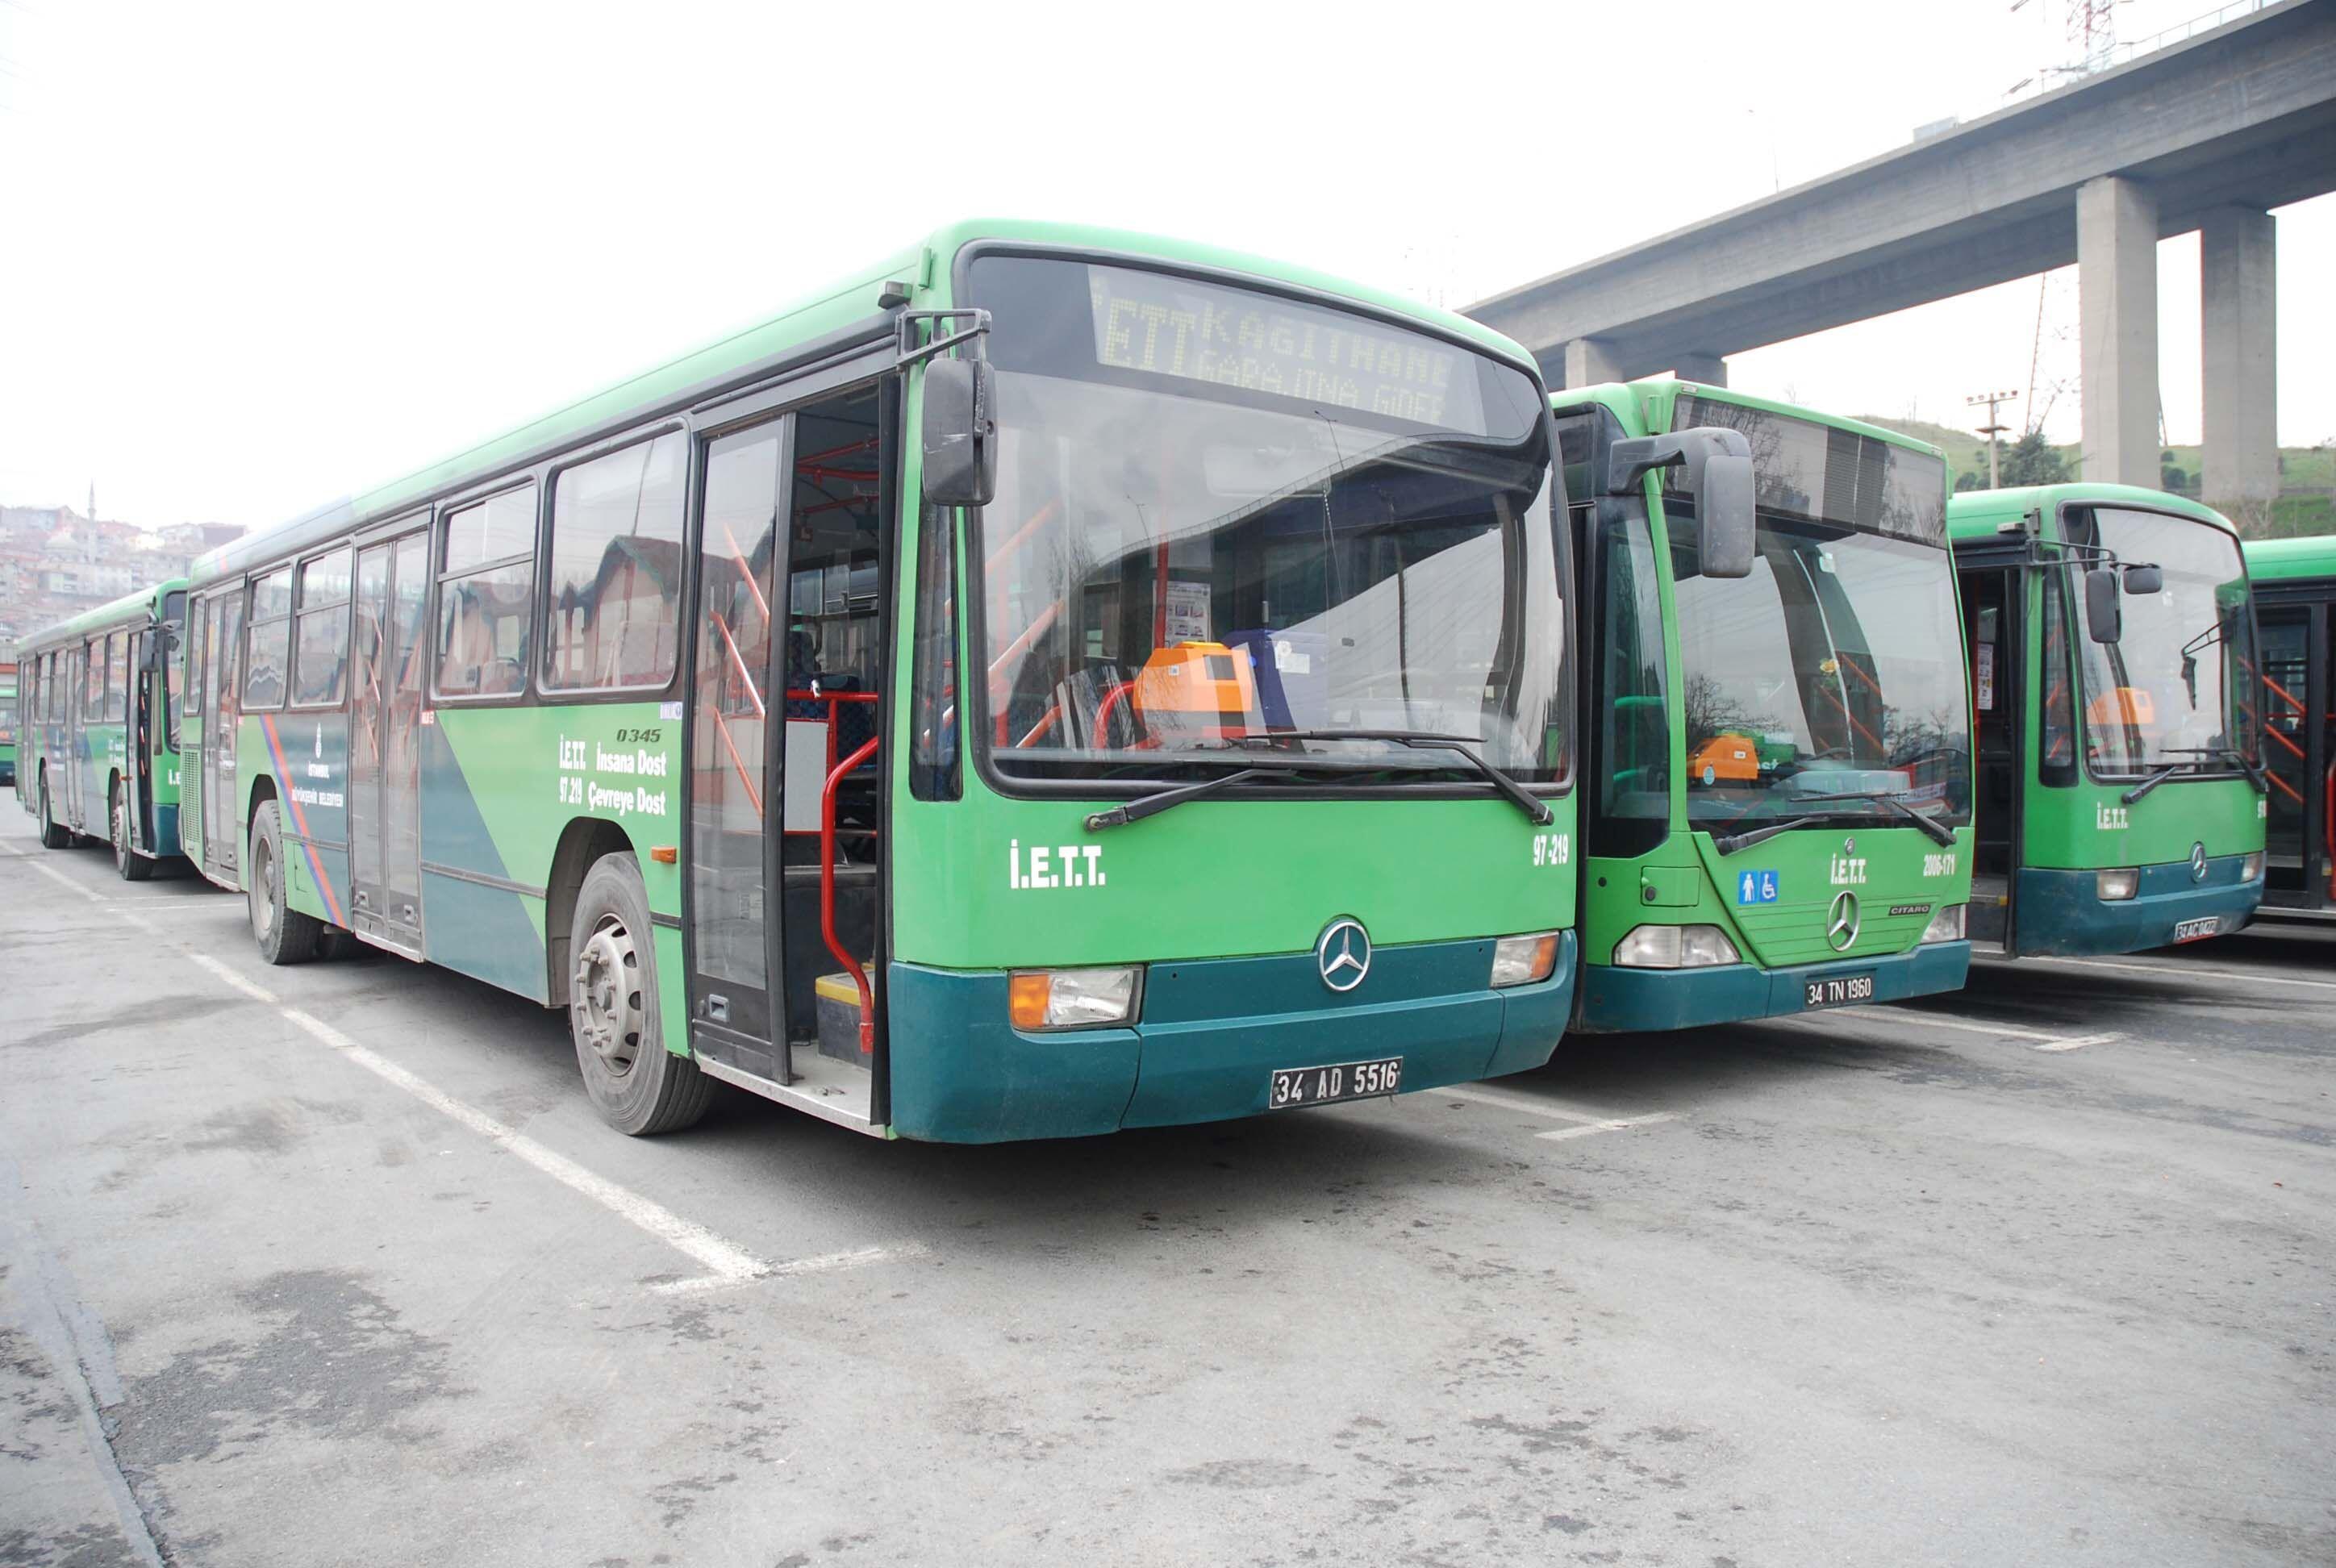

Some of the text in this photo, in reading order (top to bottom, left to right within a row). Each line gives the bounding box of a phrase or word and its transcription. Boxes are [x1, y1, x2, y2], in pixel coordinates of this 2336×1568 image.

[596, 741, 635, 774] İnsana
[637, 749, 667, 777] Dost
[588, 780, 634, 816] Çevreye
[636, 786, 665, 816] Dost
[1010, 838, 1106, 889] İ.E.T.T.
[1891, 906, 1929, 915] CITARO
[1808, 977, 1871, 1004] 34 TN 1960
[1277, 1061, 1398, 1103] 34 AD 5516
